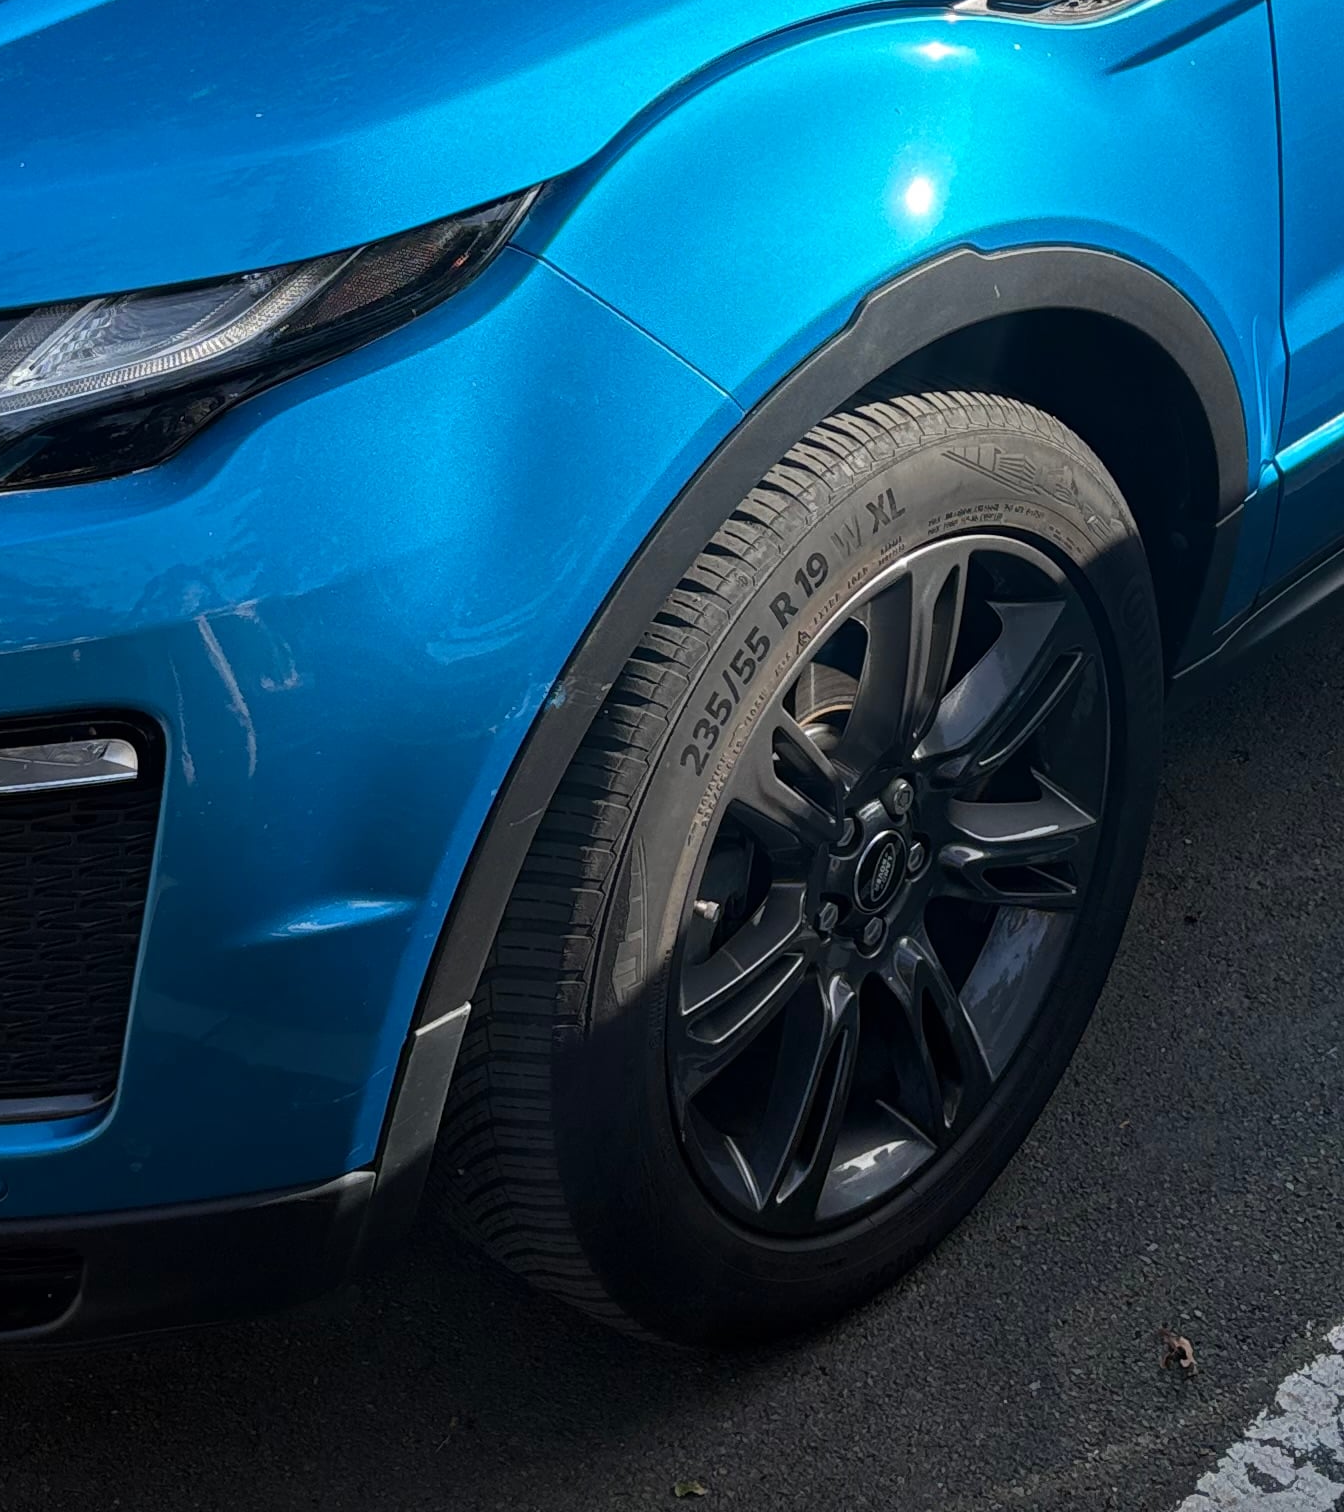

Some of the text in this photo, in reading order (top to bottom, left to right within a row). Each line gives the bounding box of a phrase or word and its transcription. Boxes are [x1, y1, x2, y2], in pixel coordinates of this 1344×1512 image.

[680, 626, 771, 777] 235/55
[769, 591, 799, 632] R
[794, 552, 830, 599] 19
[865, 487, 906, 535] XL
